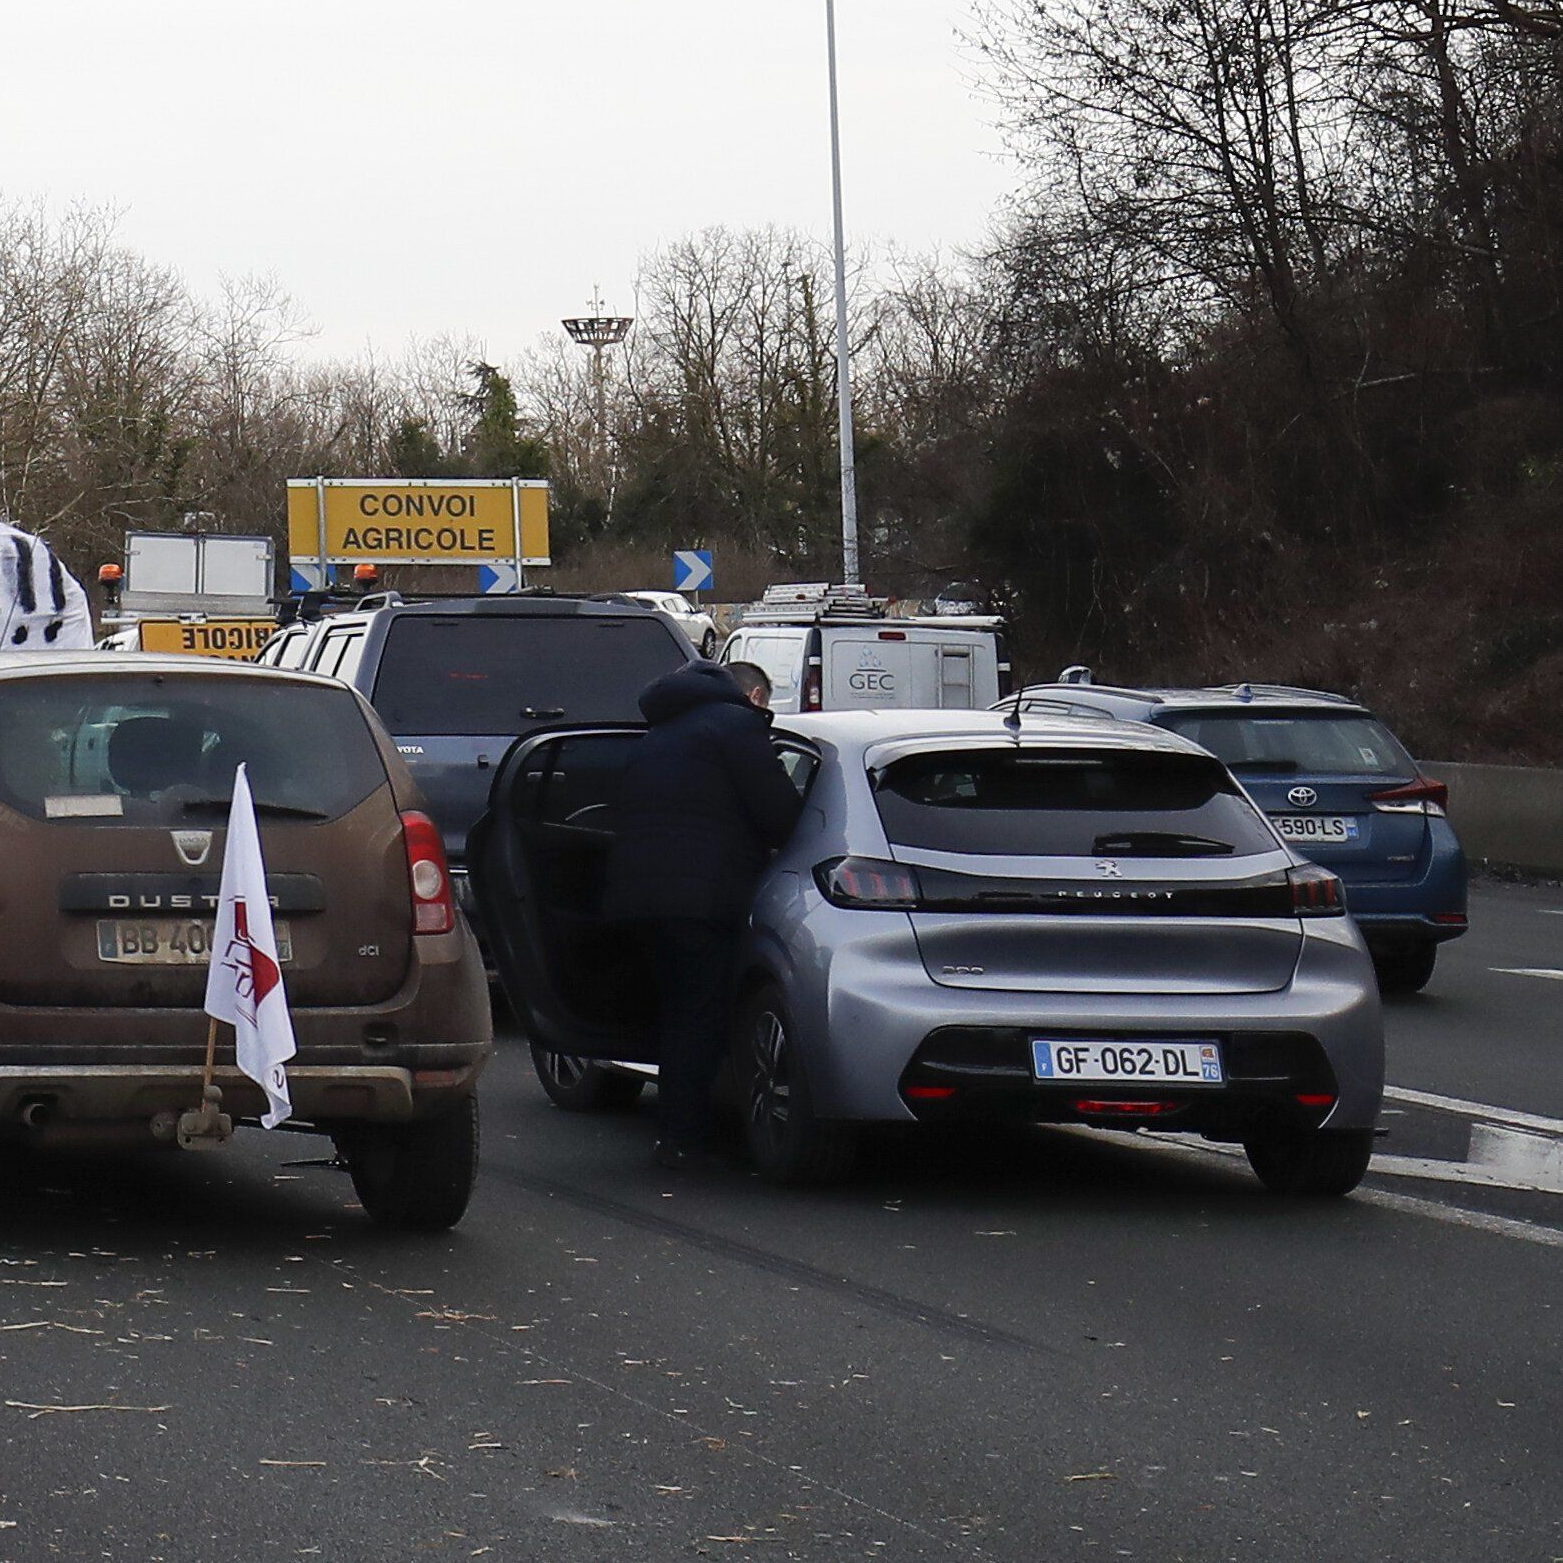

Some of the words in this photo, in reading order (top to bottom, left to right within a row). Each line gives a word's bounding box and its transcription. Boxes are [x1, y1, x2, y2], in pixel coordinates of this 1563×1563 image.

[359, 493, 475, 517] CONVOI
[341, 527, 496, 552] AGRICOLE
[849, 673, 895, 691] GEC
[396, 745, 425, 754] YOTA
[108, 894, 280, 909] DUSTR
[1057, 890, 1173, 900] PEUGEOT
[1056, 1046, 1200, 1077] GF-062-DL
